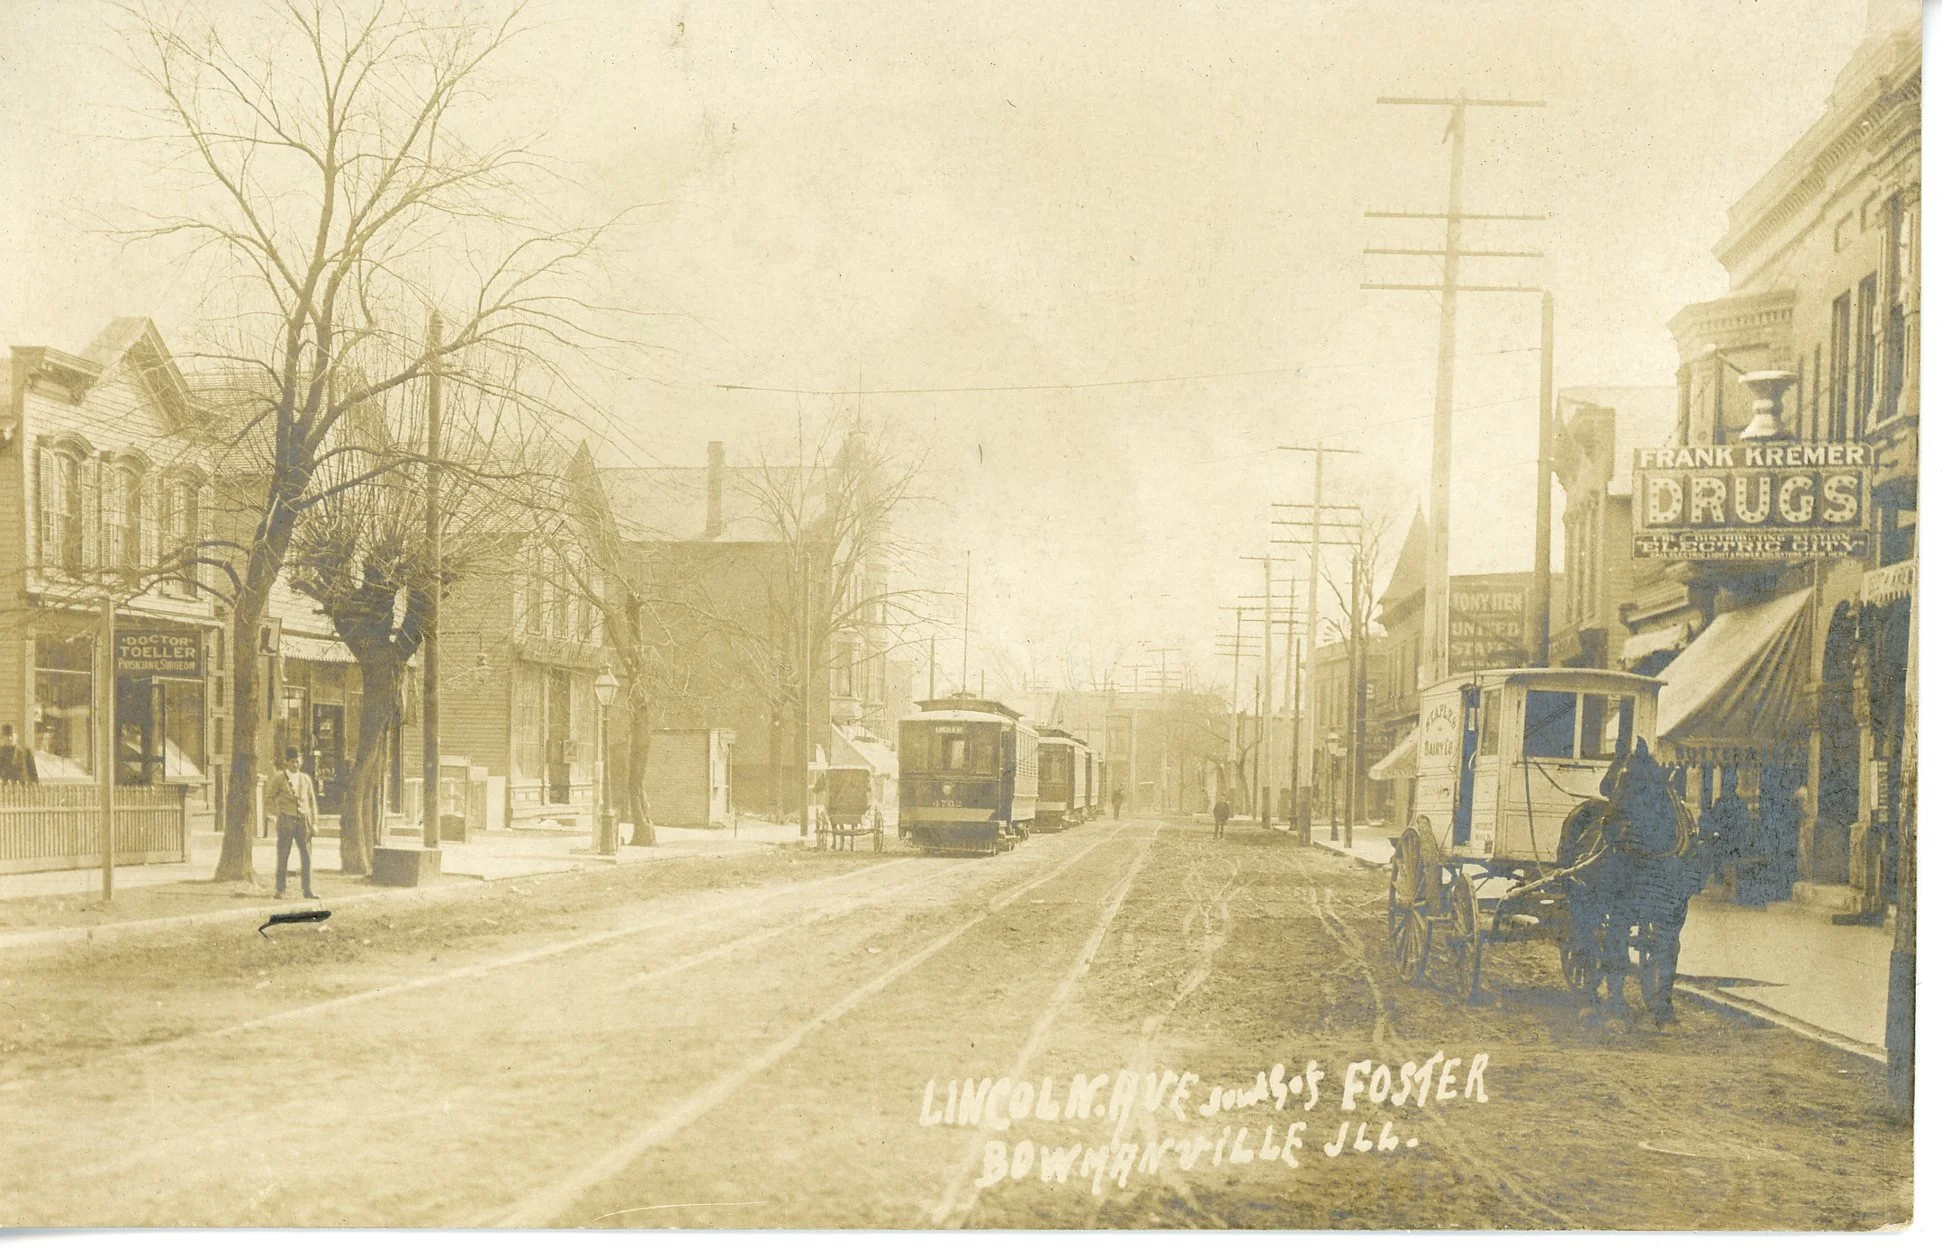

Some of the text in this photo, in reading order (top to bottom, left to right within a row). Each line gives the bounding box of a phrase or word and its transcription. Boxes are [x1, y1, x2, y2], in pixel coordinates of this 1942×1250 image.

[1640, 445, 1865, 468] FRANK KREMER
[1648, 475, 1859, 523] DRUGS
[126, 634, 188, 646] DOCTOR
[119, 646, 196, 658] TOELLER
[1341, 1050, 1490, 1110] FOSTER
